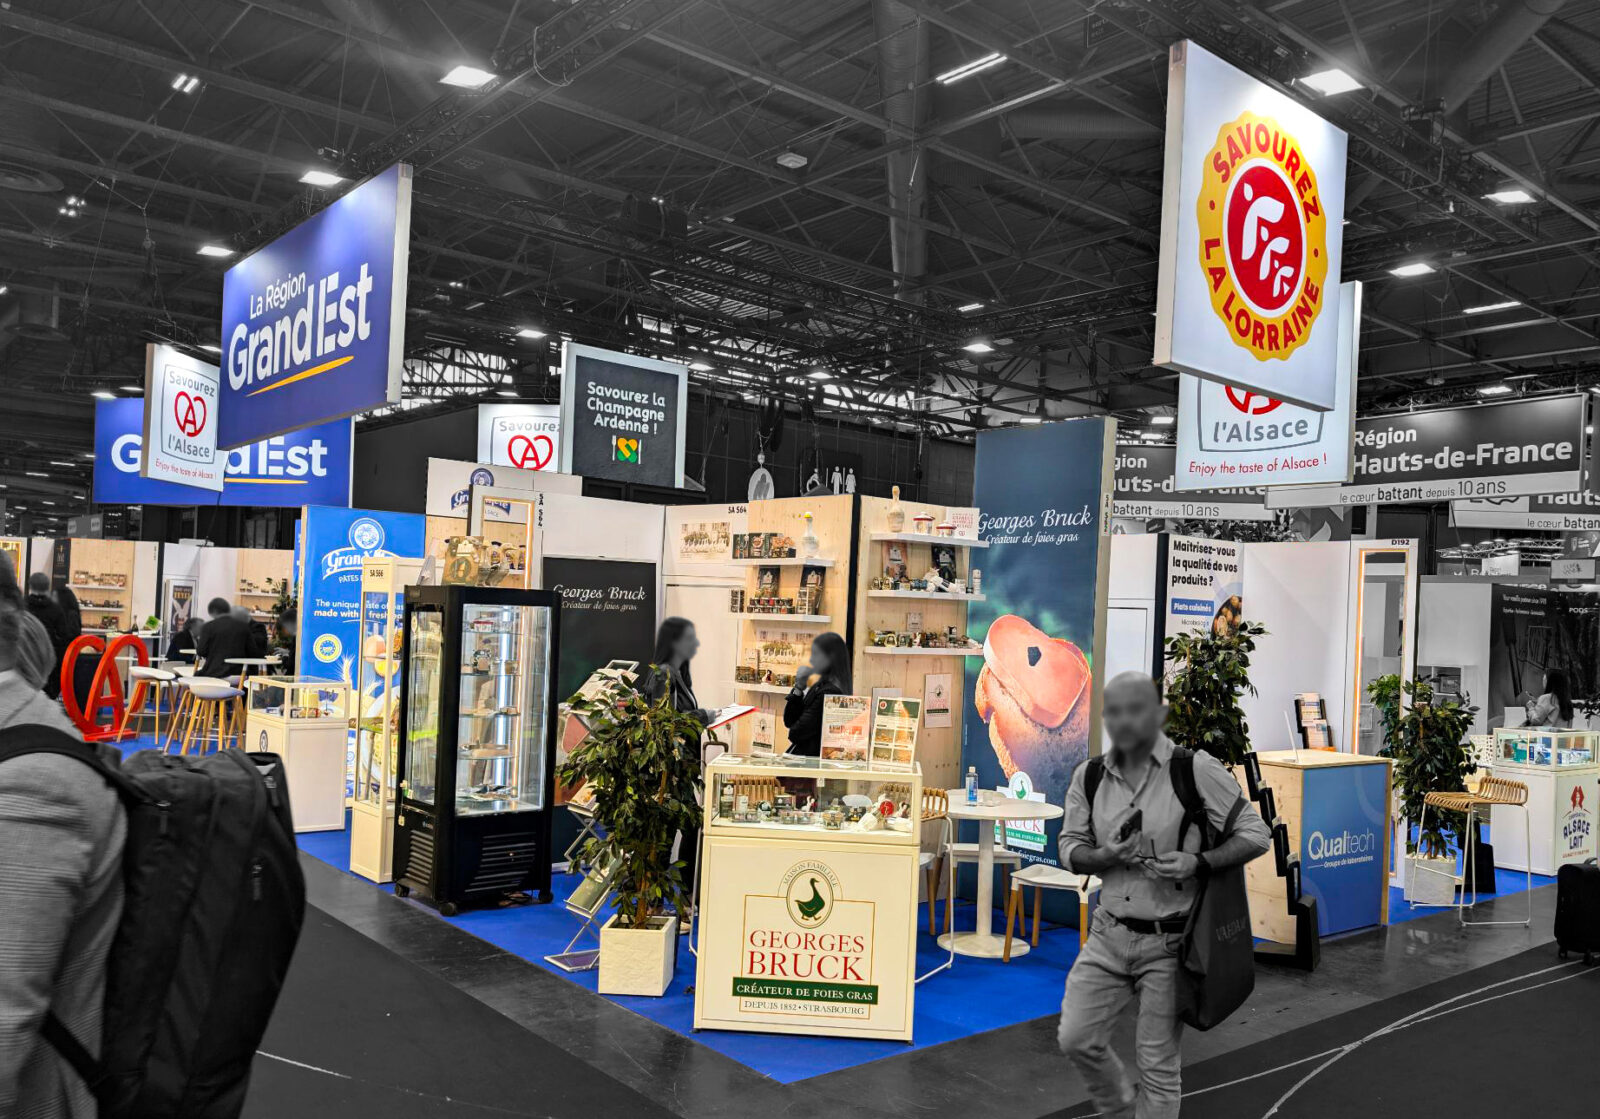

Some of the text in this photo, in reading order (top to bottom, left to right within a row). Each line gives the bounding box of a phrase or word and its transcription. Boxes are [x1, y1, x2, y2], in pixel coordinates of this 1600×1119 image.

[1213, 123, 1320, 223] SAVOUREZ
[250, 271, 306, 320] La Région
[1204, 238, 1320, 352] LA LORRAINE
[169, 370, 215, 398] Savourez
[587, 381, 666, 407] Savourez la
[587, 398, 665, 421] Champagne
[594, 414, 649, 434] Ardenne
[1214, 420, 1308, 443] l'Alsace
[168, 434, 210, 458] l'Alsace
[1354, 427, 1417, 449] Région
[1114, 454, 1147, 471] gion
[1189, 461, 1216, 477] Enjoy
[1220, 461, 1236, 474] the
[1239, 460, 1263, 473] taste
[1267, 457, 1278, 472] of
[1281, 456, 1319, 471] Alsace
[1353, 441, 1573, 475] Hauts-de-France
[1377, 486, 1423, 501] battant
[1425, 486, 1455, 500] depuis
[1458, 481, 1473, 496] 10
[1477, 480, 1506, 495] ans
[1041, 505, 1093, 527] Bruck
[1181, 504, 1194, 516] 10
[1196, 505, 1219, 517] ans
[1022, 533, 1032, 543] de
[1033, 532, 1055, 546] foies
[1056, 533, 1080, 545] gras
[1173, 540, 1236, 557] Maîtrisez-vous
[1172, 556, 1238, 573] la qualité de vos
[1171, 573, 1208, 587] produits
[608, 585, 647, 600] Bruck
[314, 609, 338, 617] made
[340, 609, 359, 618] with
[332, 601, 360, 609] unique
[1563, 820, 1590, 839] ALSACE
[1308, 828, 1374, 860] Qualtech
[783, 862, 838, 888] MAISON FAMILIALE
[749, 929, 865, 953] GEORGES
[747, 950, 864, 981] BRUCK
[736, 983, 873, 1001] CRÉATEUR DE FOIES GRAS
[744, 1000, 779, 1011] DEPUIS
[803, 1003, 865, 1015] STRASBOURG
